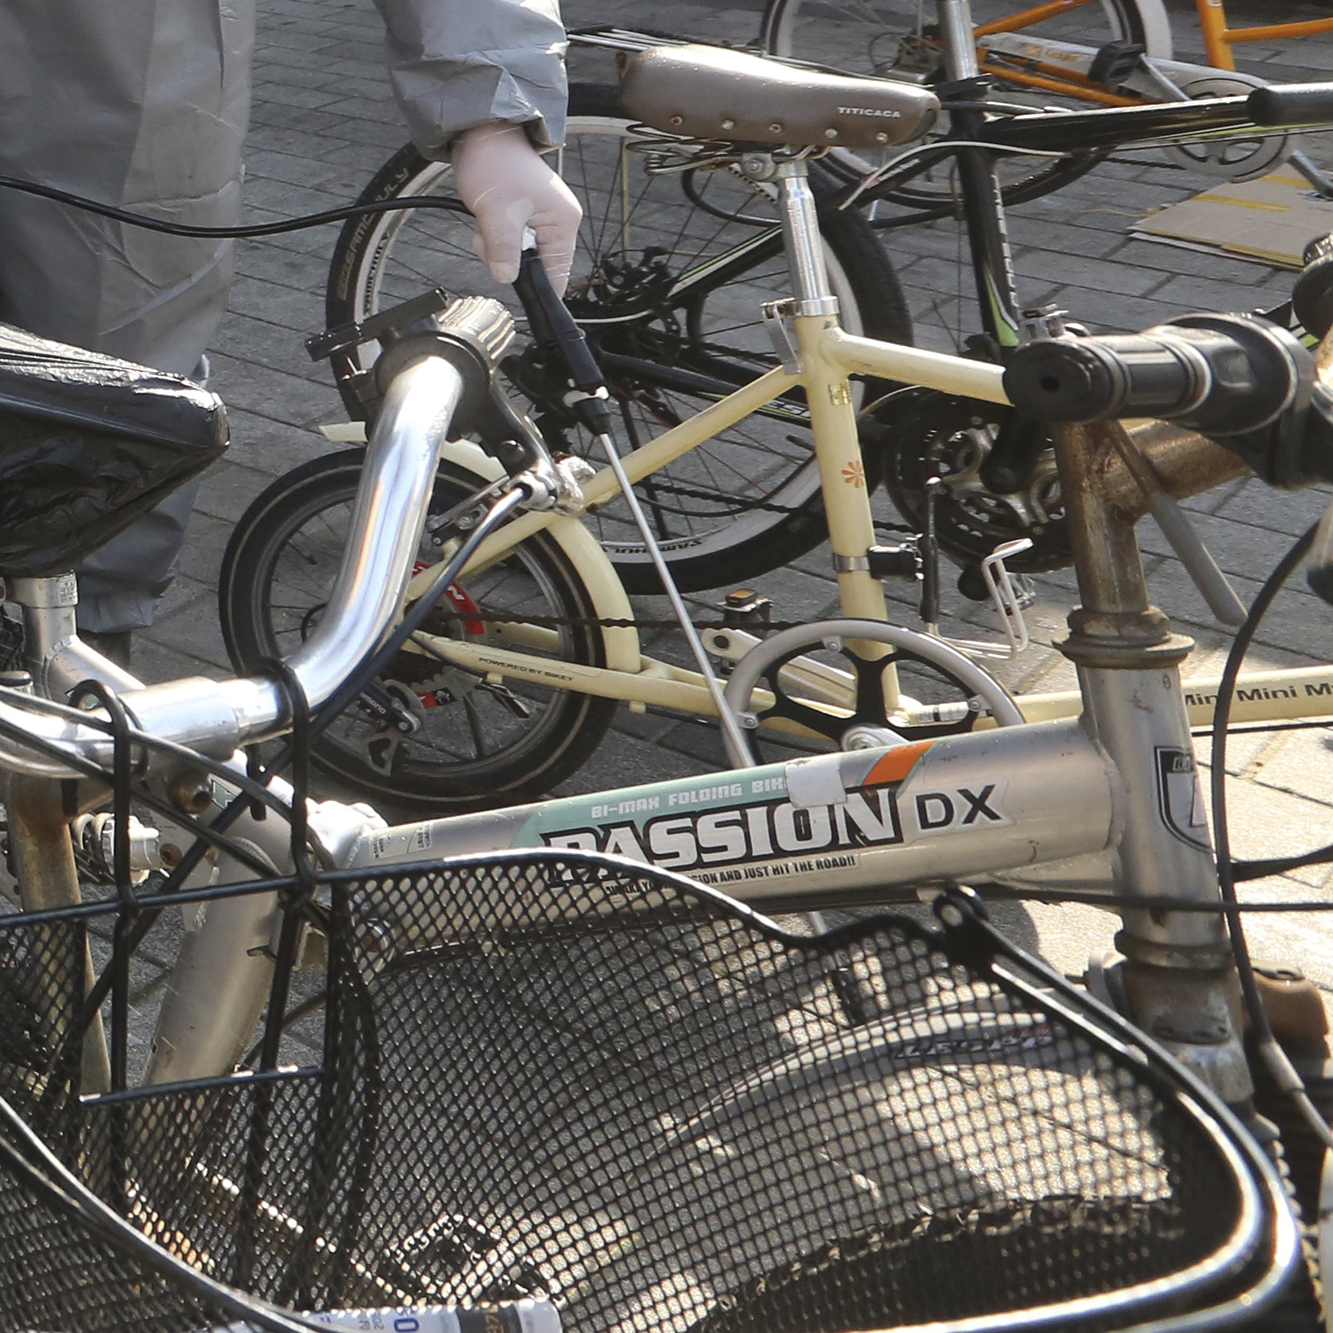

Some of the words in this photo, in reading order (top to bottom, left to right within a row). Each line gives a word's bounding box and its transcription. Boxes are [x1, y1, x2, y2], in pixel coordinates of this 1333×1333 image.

[837, 106, 902, 119] TITICACA
[345, 167, 409, 266] SAMCULY
[478, 657, 527, 672] POWERED
[528, 666, 541, 675] BY
[543, 669, 574, 682] BIKEY
[1237, 685, 1298, 702] Mini
[669, 781, 743, 806] FOLDING
[752, 776, 788, 795] BIK
[547, 788, 898, 870] PASSION
[916, 785, 1003, 830] DX
[720, 870, 742, 882] AND
[744, 867, 770, 880] JUST
[773, 864, 791, 876] HIT
[793, 861, 814, 873] THE
[816, 856, 856, 870] ROAD!!
